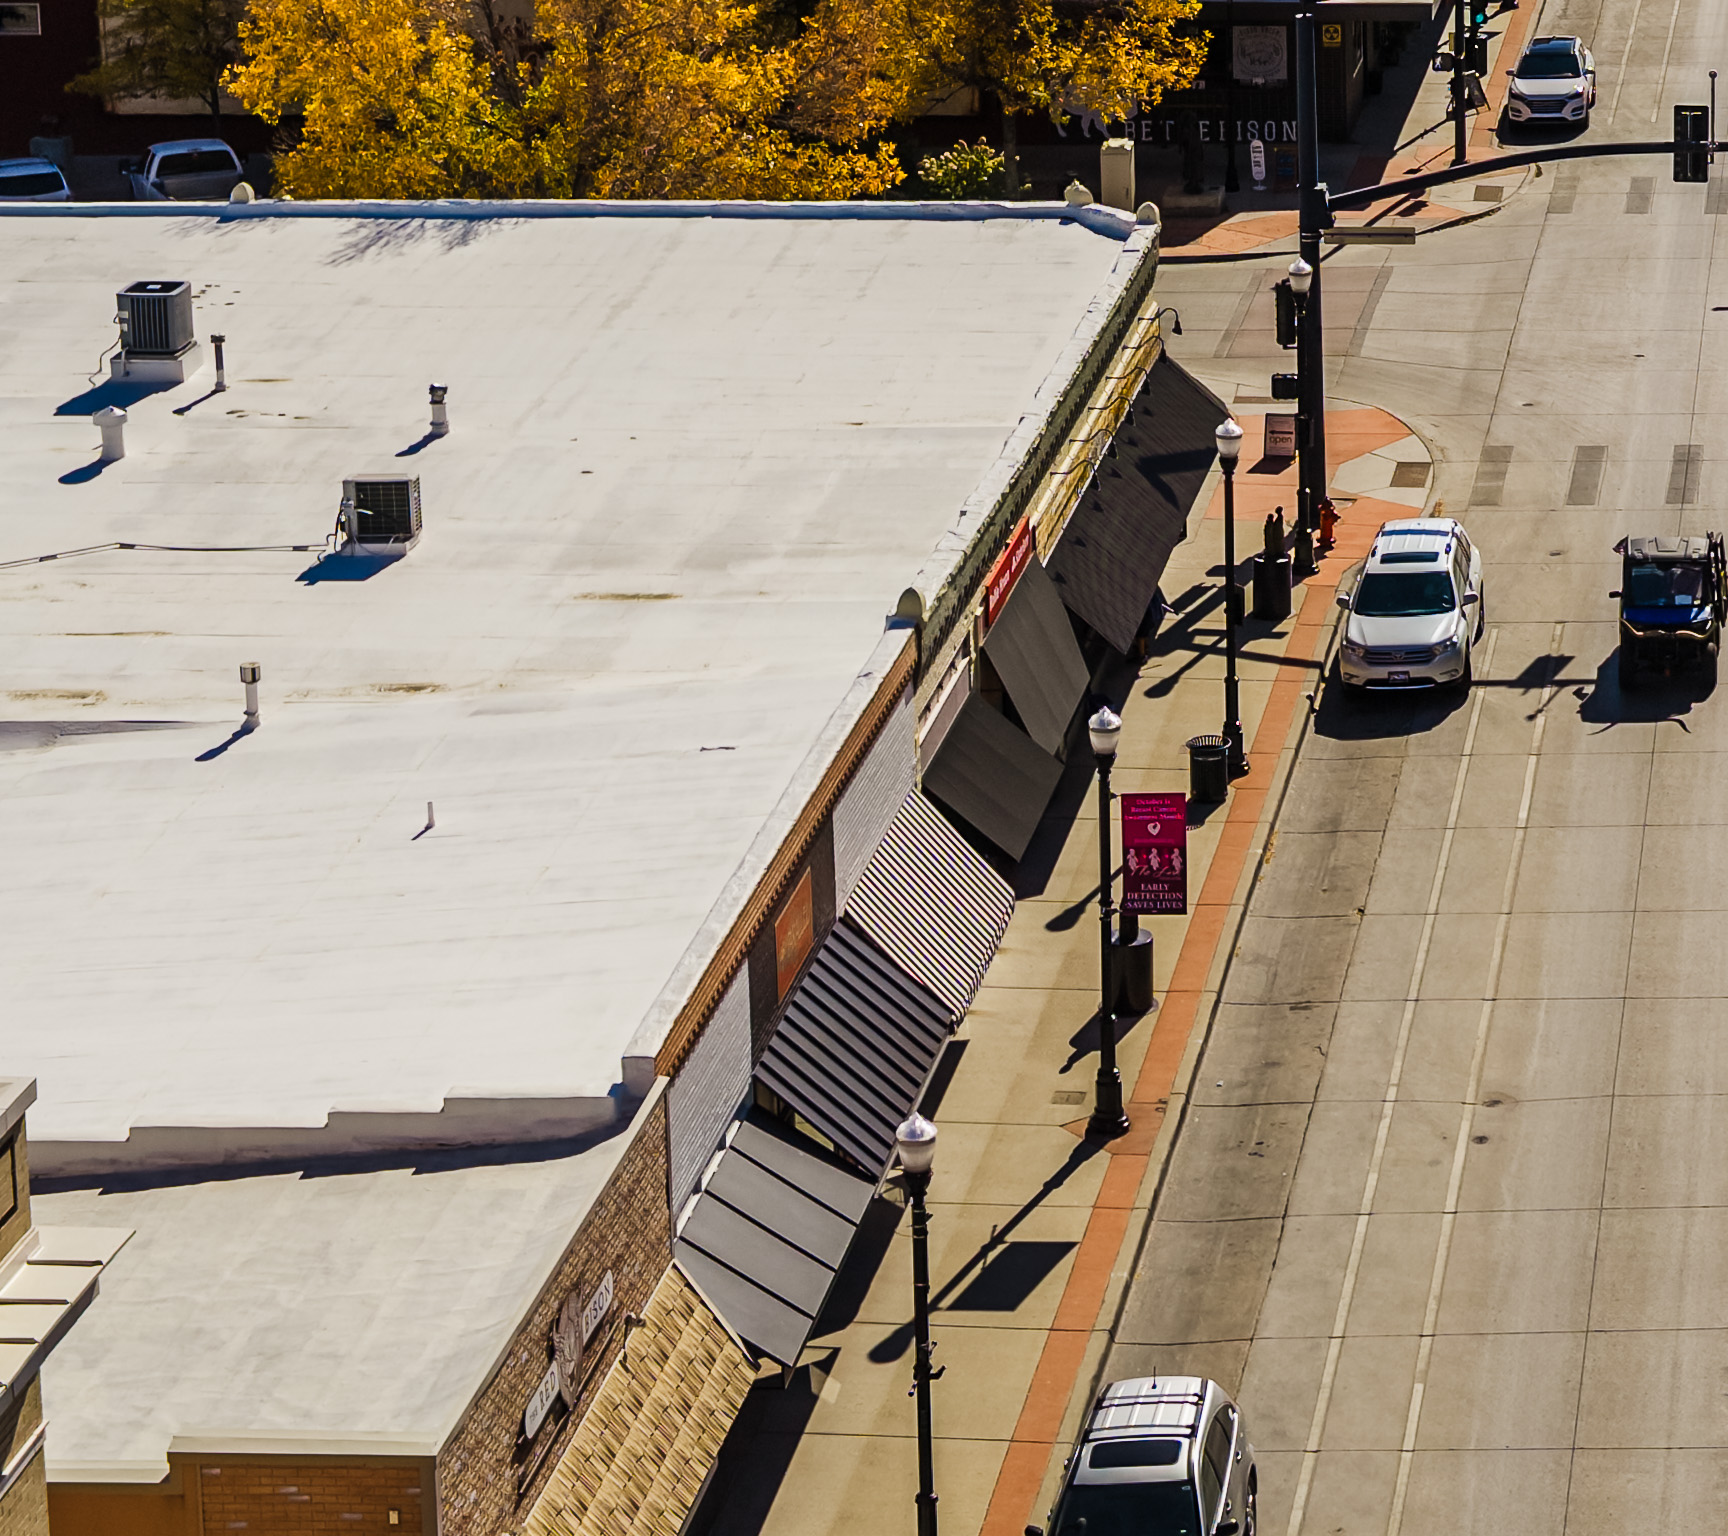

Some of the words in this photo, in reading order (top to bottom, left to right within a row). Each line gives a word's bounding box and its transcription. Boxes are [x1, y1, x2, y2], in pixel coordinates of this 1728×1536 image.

[1159, 120, 1210, 142] TE
[1269, 435, 1293, 446] open
[1141, 883, 1169, 891] EARLY
[1127, 892, 1183, 900] DETECTION
[1127, 901, 1154, 909] SAVES
[1157, 901, 1183, 909] LIVES
[540, 1371, 556, 1412] RED
[584, 1282, 611, 1334] BISON
